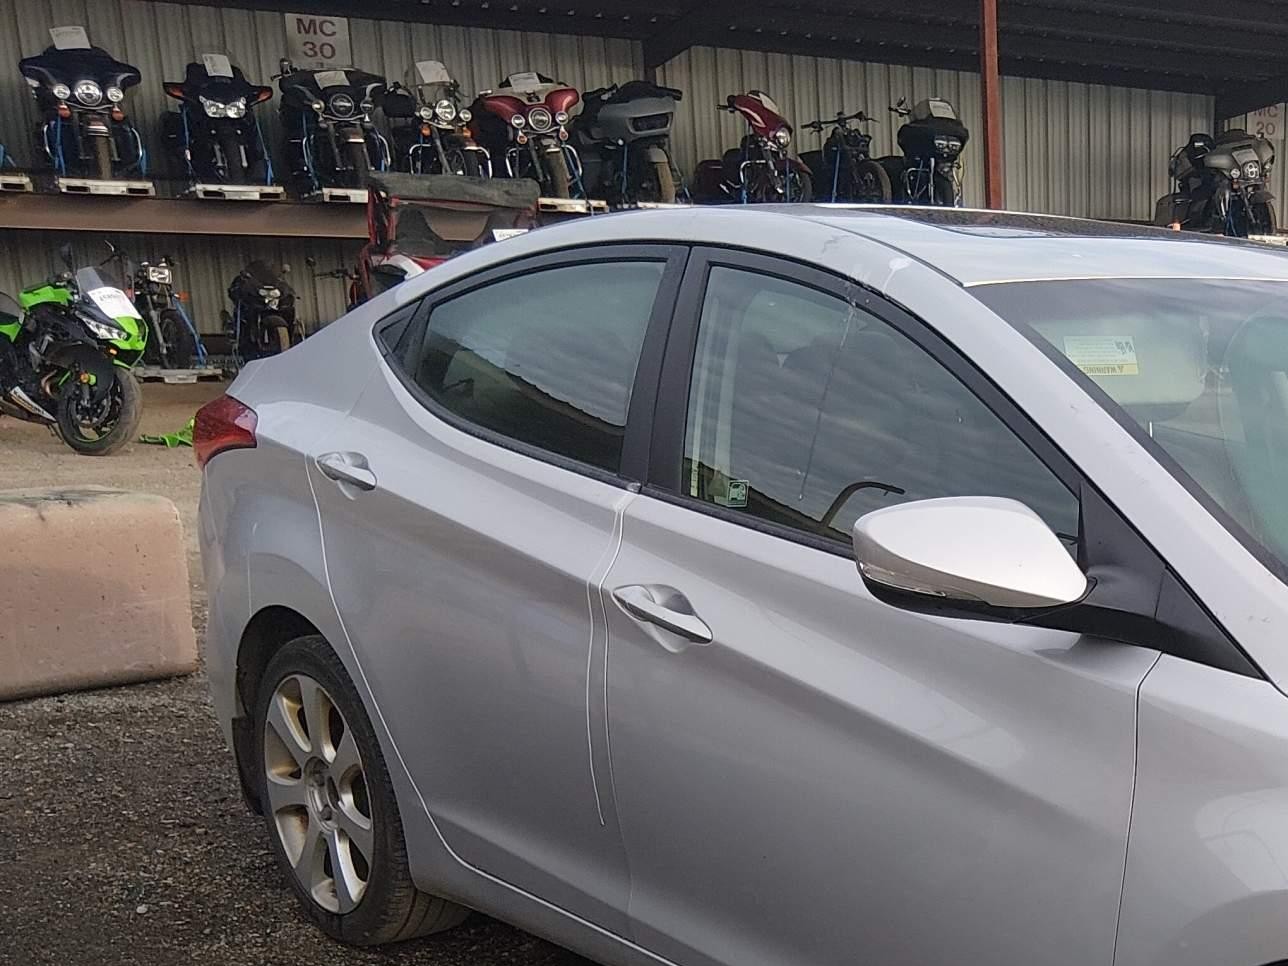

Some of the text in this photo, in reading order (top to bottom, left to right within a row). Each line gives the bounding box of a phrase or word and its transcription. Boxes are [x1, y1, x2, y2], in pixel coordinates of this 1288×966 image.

[295, 17, 337, 37] MC
[303, 41, 336, 59] 30
[1255, 121, 1276, 135] 20
